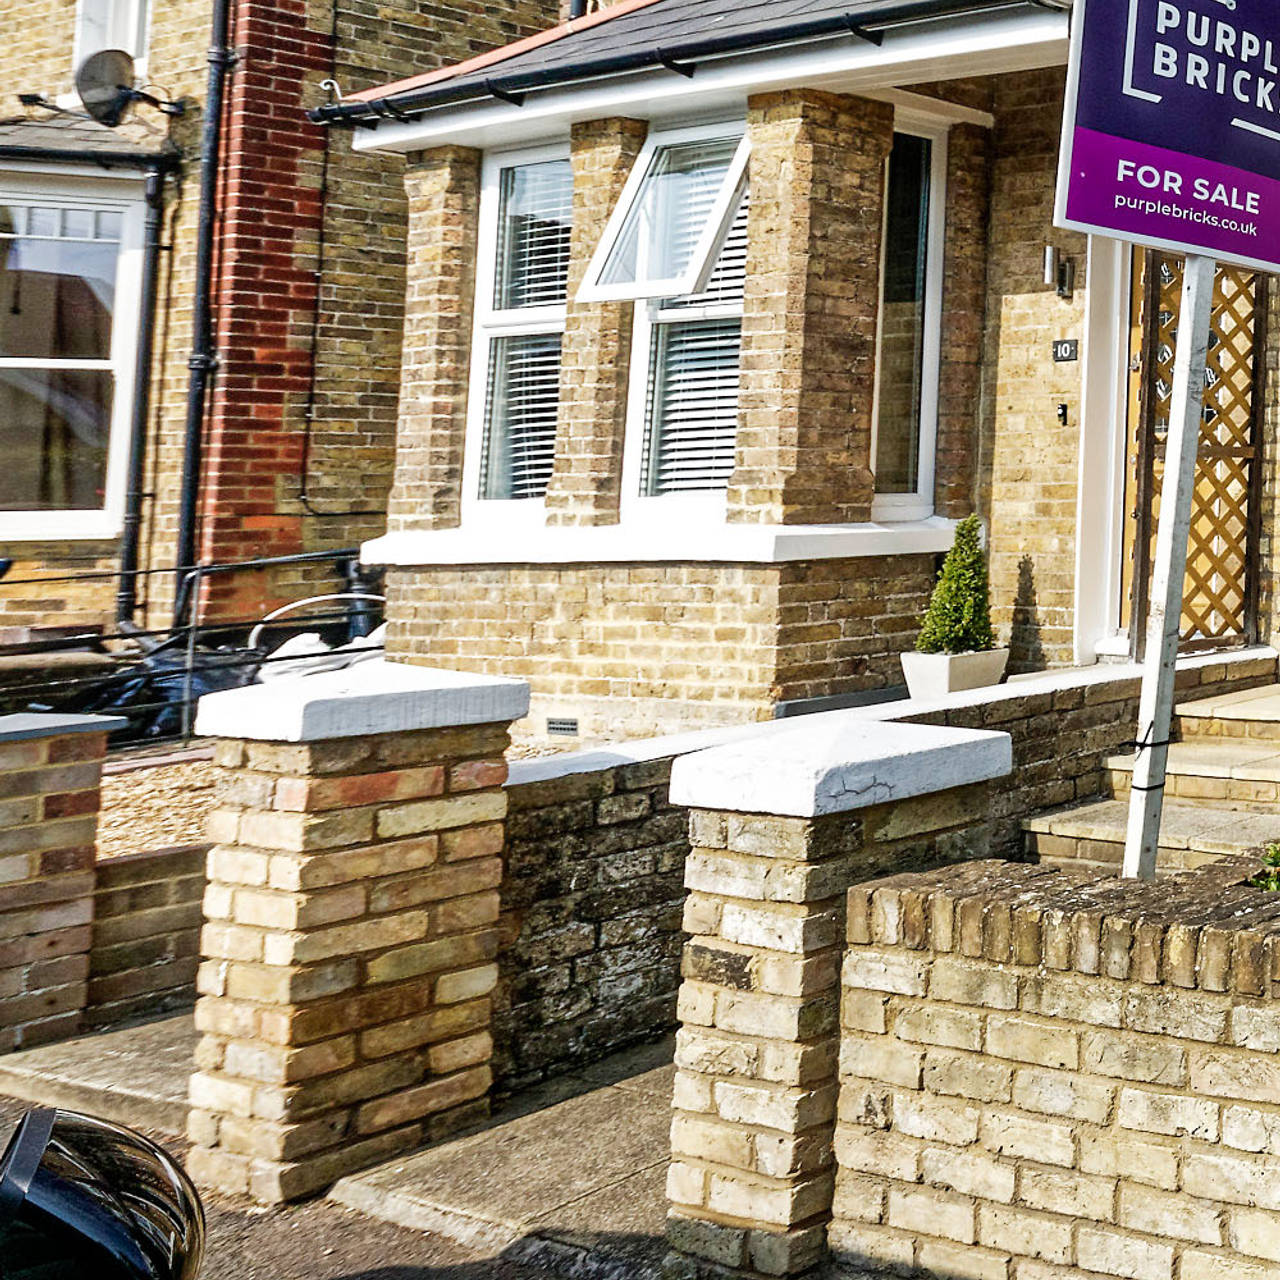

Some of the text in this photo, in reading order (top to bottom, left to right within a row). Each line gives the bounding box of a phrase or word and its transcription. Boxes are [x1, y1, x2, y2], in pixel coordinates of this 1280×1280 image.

[1117, 159, 1260, 215] FOR SALE
[1114, 194, 1257, 236] purplebricks.co.uk
[1057, 343, 1070, 357] 10
